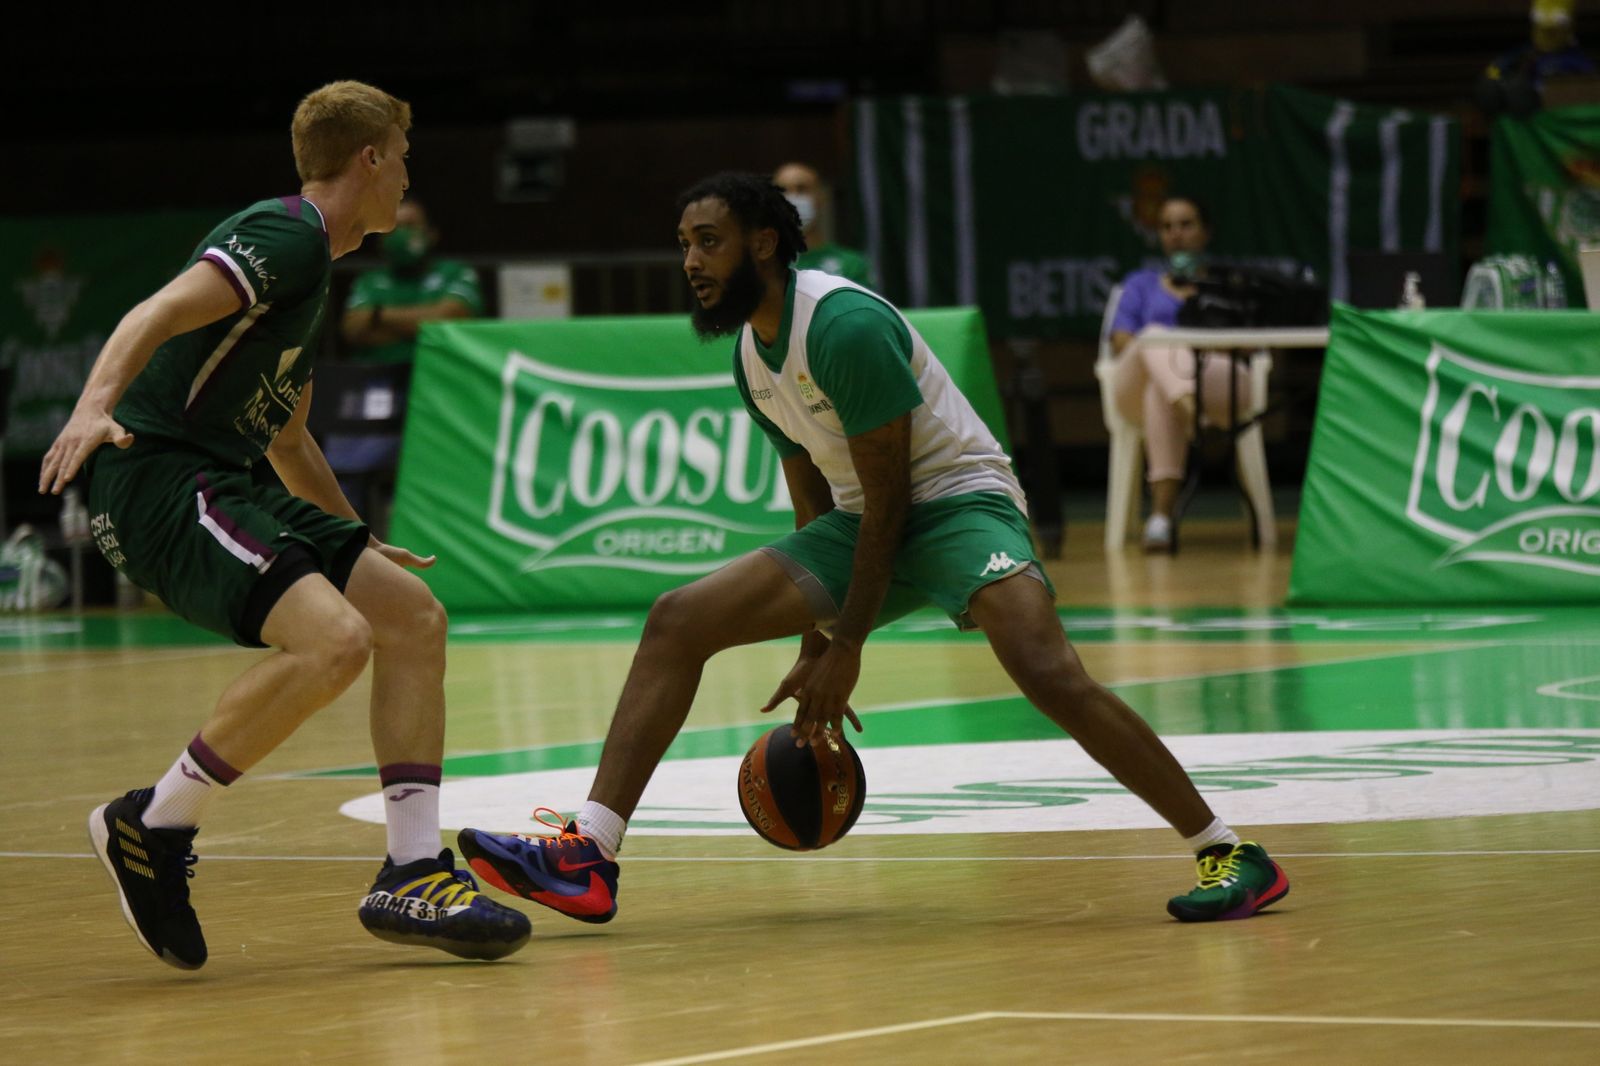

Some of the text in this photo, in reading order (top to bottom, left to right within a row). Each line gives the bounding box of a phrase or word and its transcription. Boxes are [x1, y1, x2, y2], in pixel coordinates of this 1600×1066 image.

[1076, 101, 1228, 161] GRADA
[1007, 256, 1118, 319] BETIS
[593, 527, 727, 556] ORIGEN
